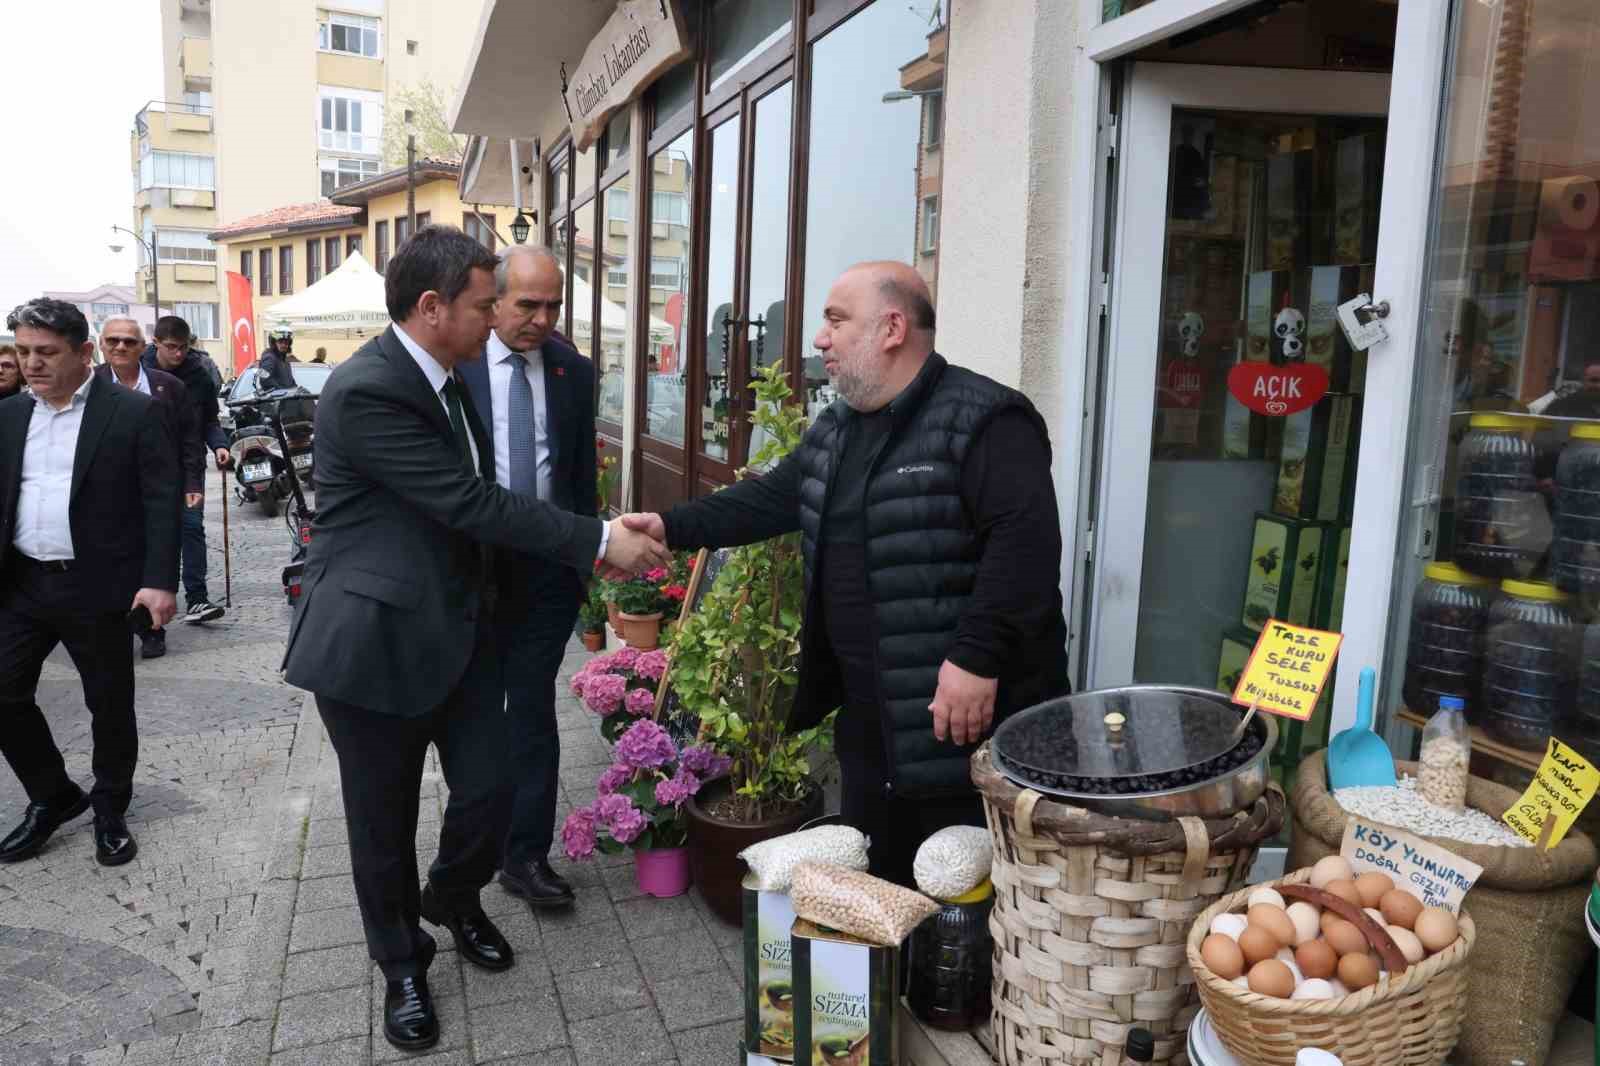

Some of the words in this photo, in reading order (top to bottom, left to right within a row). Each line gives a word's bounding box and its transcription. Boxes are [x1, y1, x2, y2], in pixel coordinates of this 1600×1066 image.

[603, 25, 651, 87] Lokantası
[1253, 375, 1303, 399] AÇIK
[1273, 625, 1320, 647] TAZE
[1265, 652, 1312, 673] SELE
[1286, 646, 1326, 662] KURU
[1266, 671, 1320, 694] TUZSUZ
[1355, 824, 1398, 852] KÖY
[1355, 847, 1401, 875] DOĞAL
[1409, 871, 1449, 898] GEZEN
[813, 994, 867, 1019] SIZMA
[827, 991, 866, 1003] naturel
